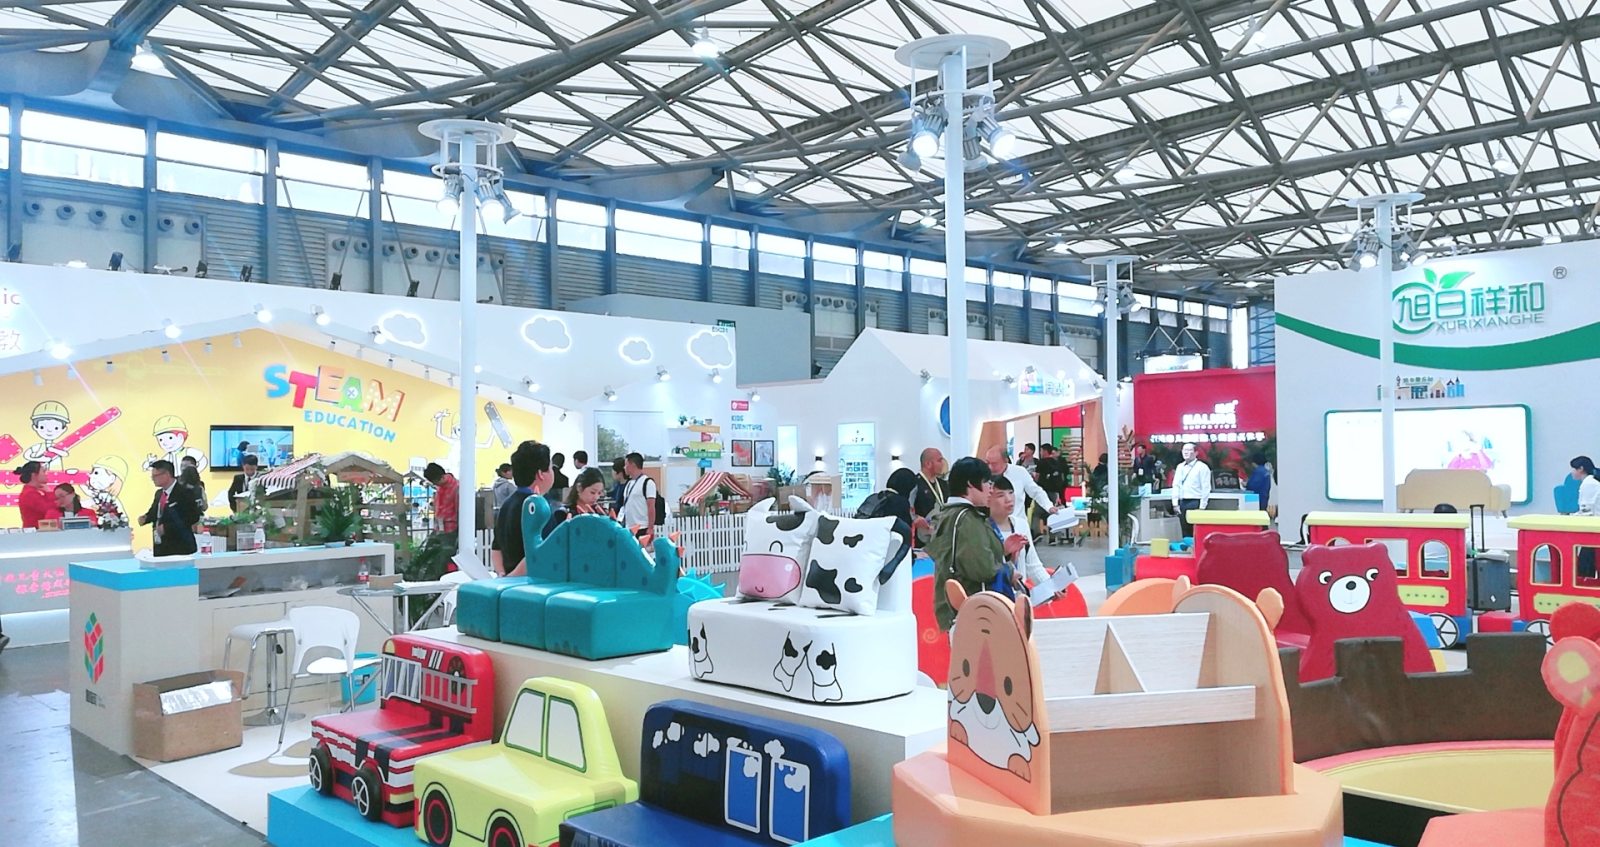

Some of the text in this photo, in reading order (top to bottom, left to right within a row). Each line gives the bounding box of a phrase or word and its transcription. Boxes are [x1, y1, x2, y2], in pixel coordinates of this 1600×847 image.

[1435, 313, 1546, 334] XURIXIANGHE
[263, 363, 406, 422] STEAM
[303, 409, 397, 443] EDUCATION
[731, 423, 763, 432] FURNITURE
